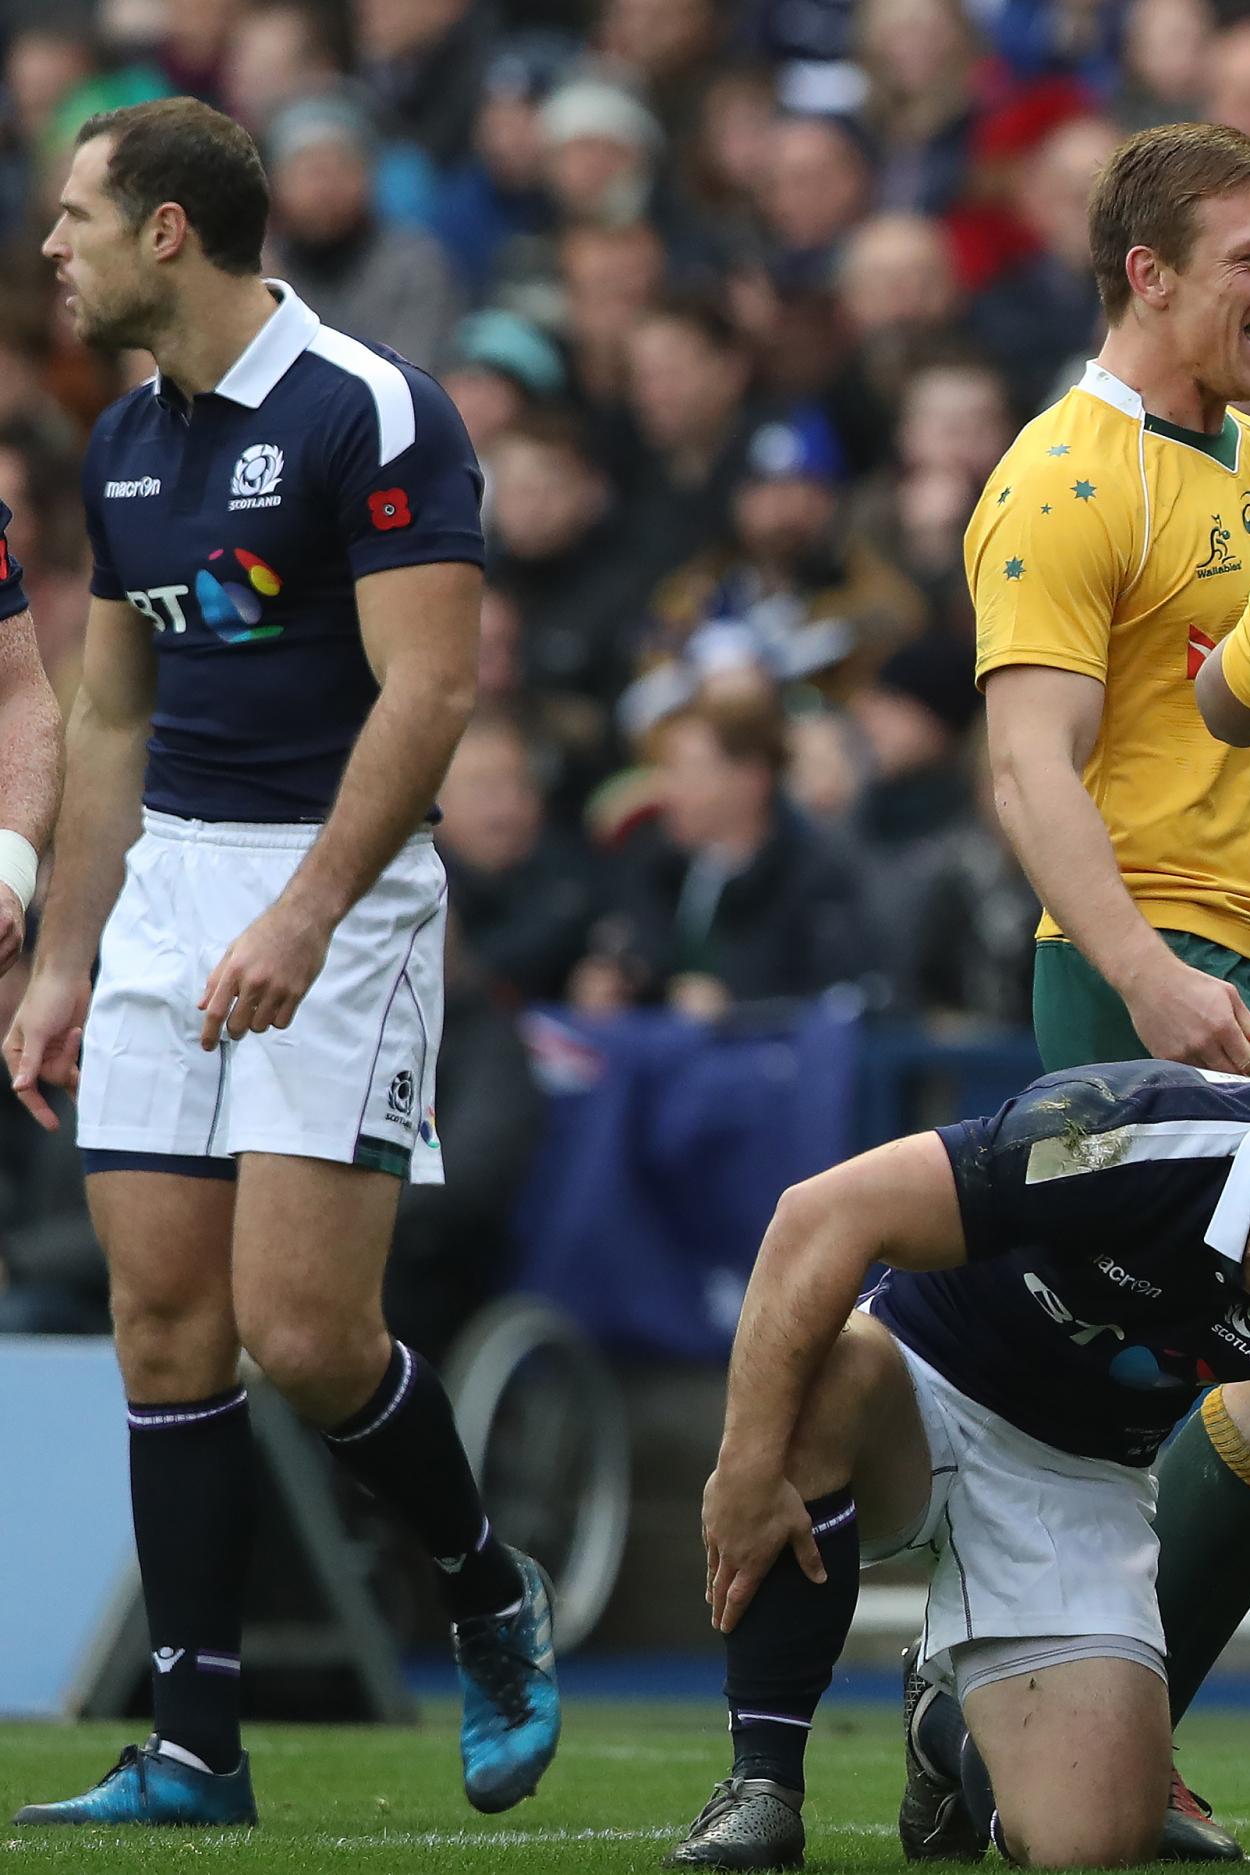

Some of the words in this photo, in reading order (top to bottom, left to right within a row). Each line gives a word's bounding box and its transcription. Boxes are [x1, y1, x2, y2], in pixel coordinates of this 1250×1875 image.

[105, 476, 161, 498] macron
[227, 494, 282, 511] SCOTLAND
[1197, 561, 1242, 579] Wallabies
